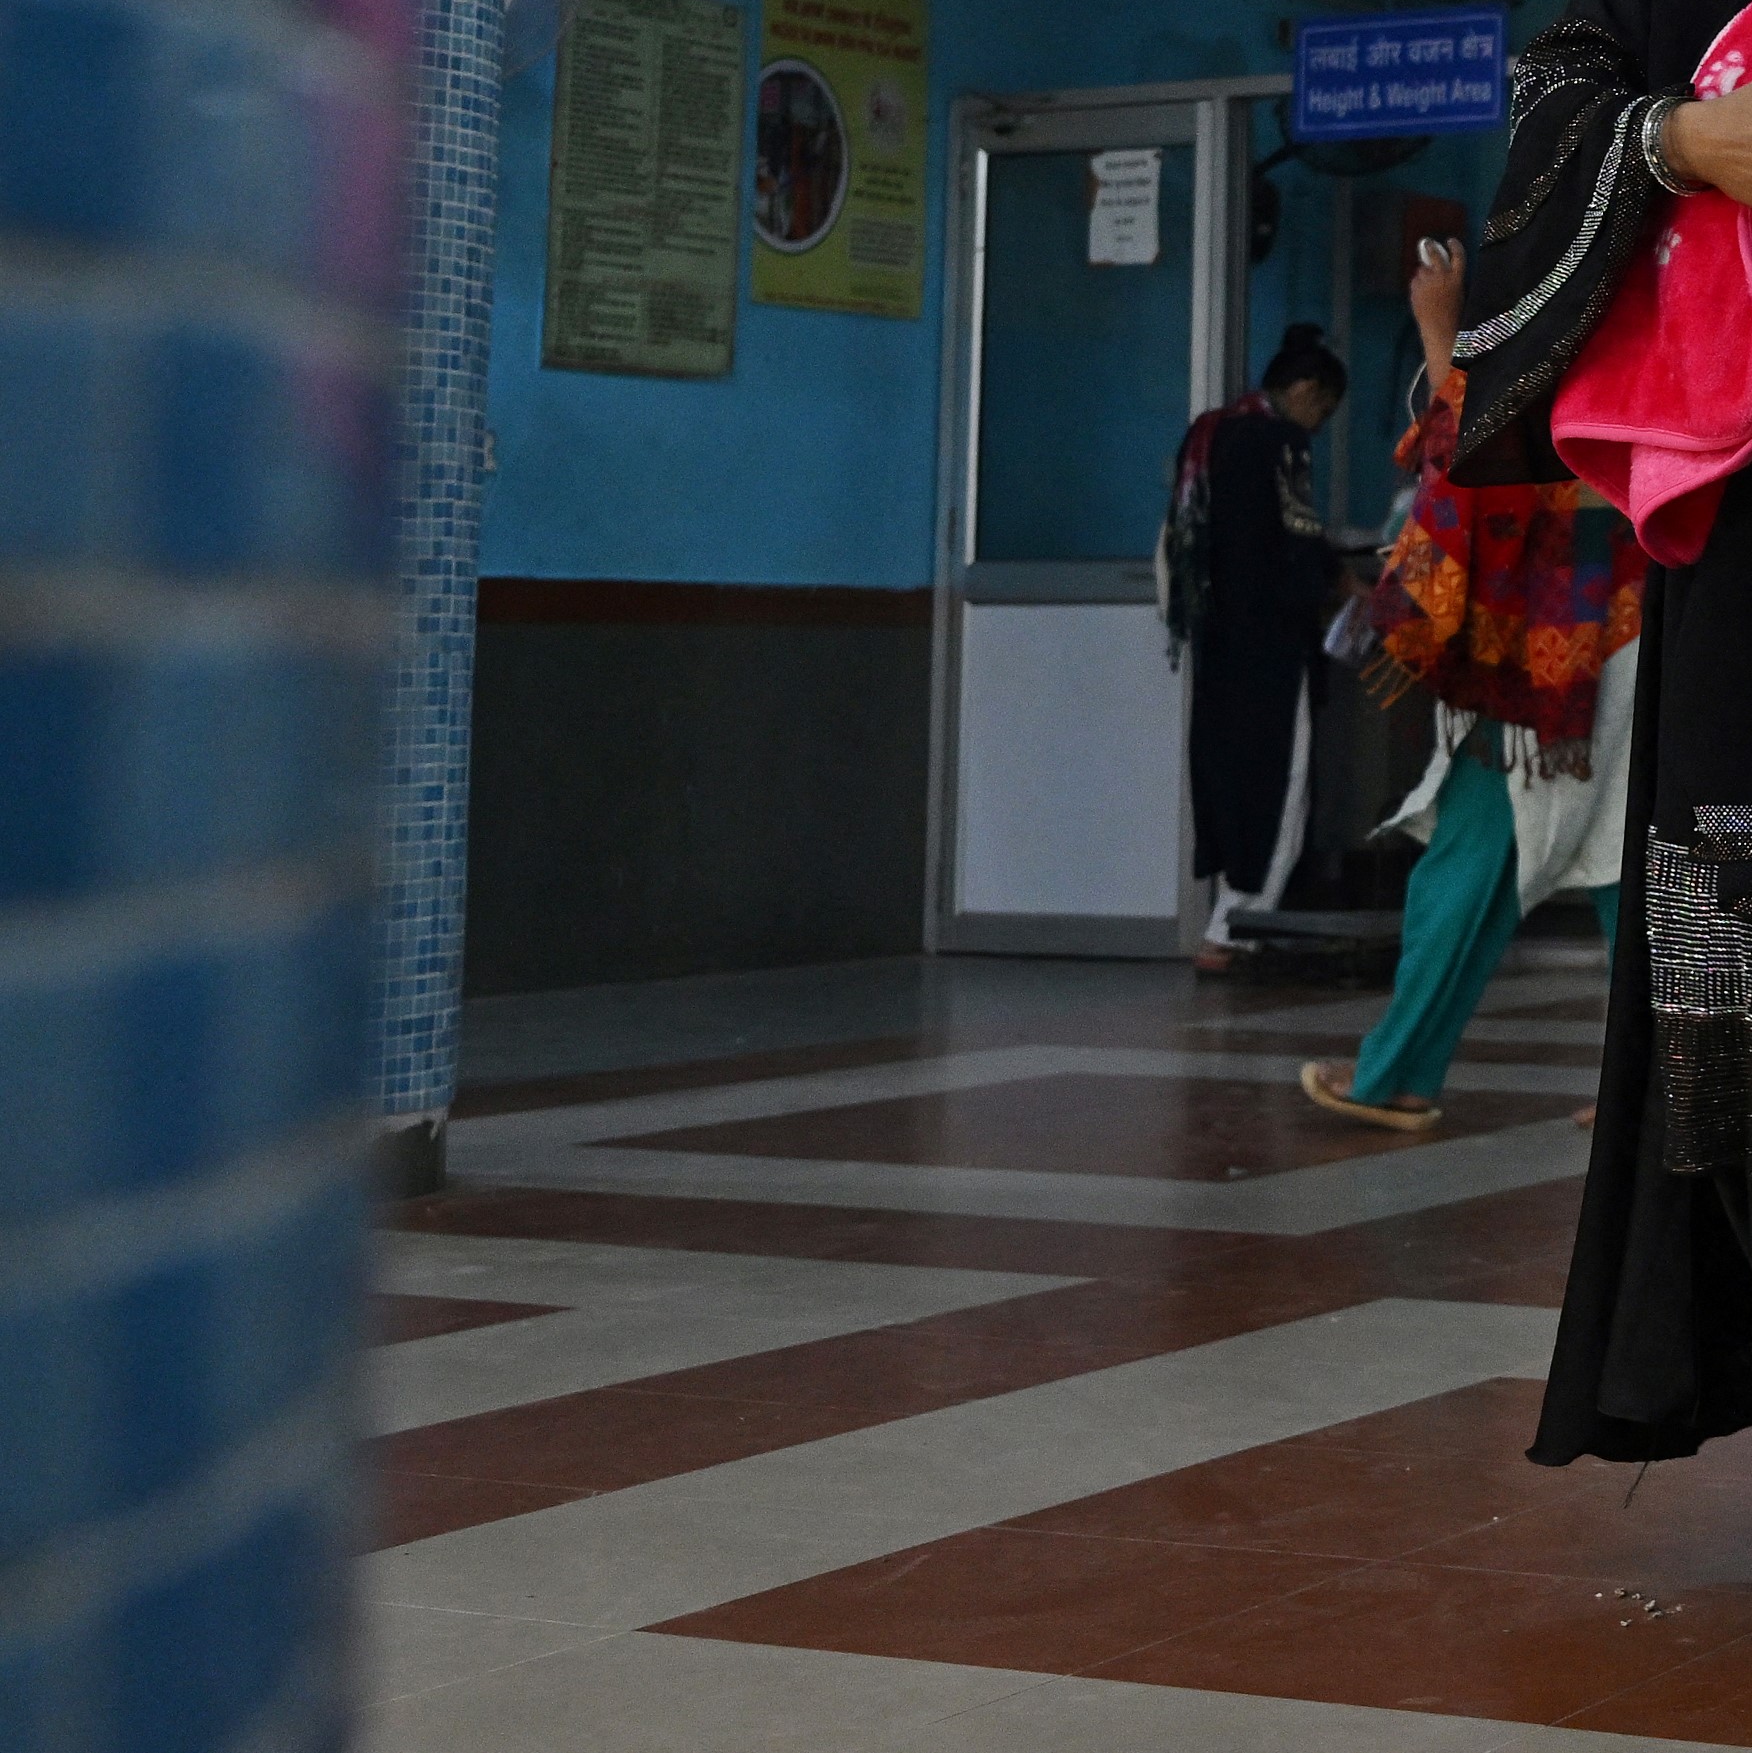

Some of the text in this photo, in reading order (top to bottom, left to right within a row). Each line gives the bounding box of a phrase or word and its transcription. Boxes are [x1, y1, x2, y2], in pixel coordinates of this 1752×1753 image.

[1308, 77, 1492, 118] Height & Weight Area
